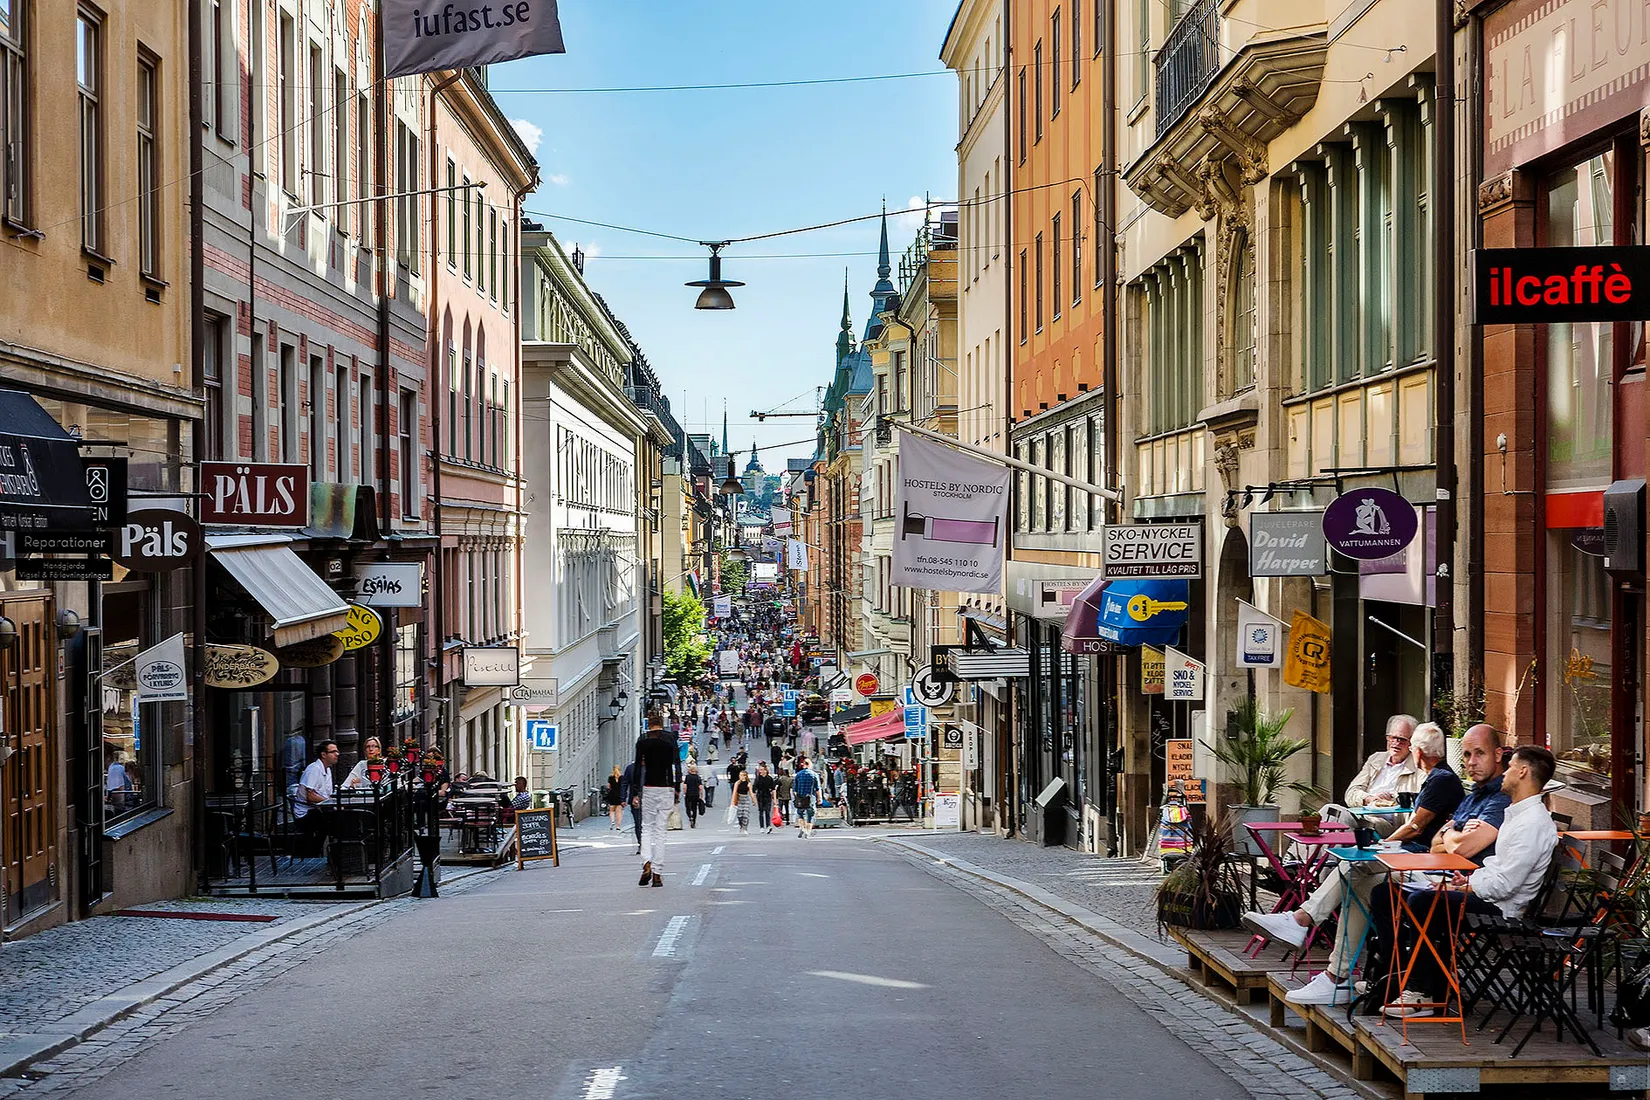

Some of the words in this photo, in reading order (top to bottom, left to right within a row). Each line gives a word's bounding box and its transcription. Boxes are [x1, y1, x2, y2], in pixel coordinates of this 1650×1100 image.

[413, 1, 530, 38] iufast.se
[1503, 44, 1536, 119] LA
[1489, 263, 1632, 306] ilcaffè
[213, 466, 295, 515] PÄLS
[904, 479, 947, 491] HOSTELS
[948, 483, 961, 492] BY
[963, 484, 1003, 495] NORDIC
[933, 491, 972, 499] STOCKHOLM
[121, 521, 188, 557] Päls
[1108, 528, 1195, 540] SKO-NYCKEL
[1253, 531, 1309, 549] David
[24, 535, 106, 550] Reparationer
[1339, 538, 1401, 548] VATTUMANNEN
[1108, 542, 1195, 560] SERVICE
[917, 556, 953, 565] tfn.08-545
[955, 559, 968, 567] 110
[970, 560, 979, 568] 10
[1107, 566, 1142, 575] KVALITET
[1145, 565, 1161, 574] TILL
[1162, 563, 1177, 574] LÅG
[1178, 564, 1197, 574] PRIS
[1256, 550, 1319, 574] Harper
[904, 566, 989, 579] www.hostelsbynordic.se
[1173, 670, 1188, 680] SKO
[1188, 670, 1195, 680] &
[1172, 681, 1195, 689] NYCKEL-
[1172, 689, 1194, 697] SERVICE
